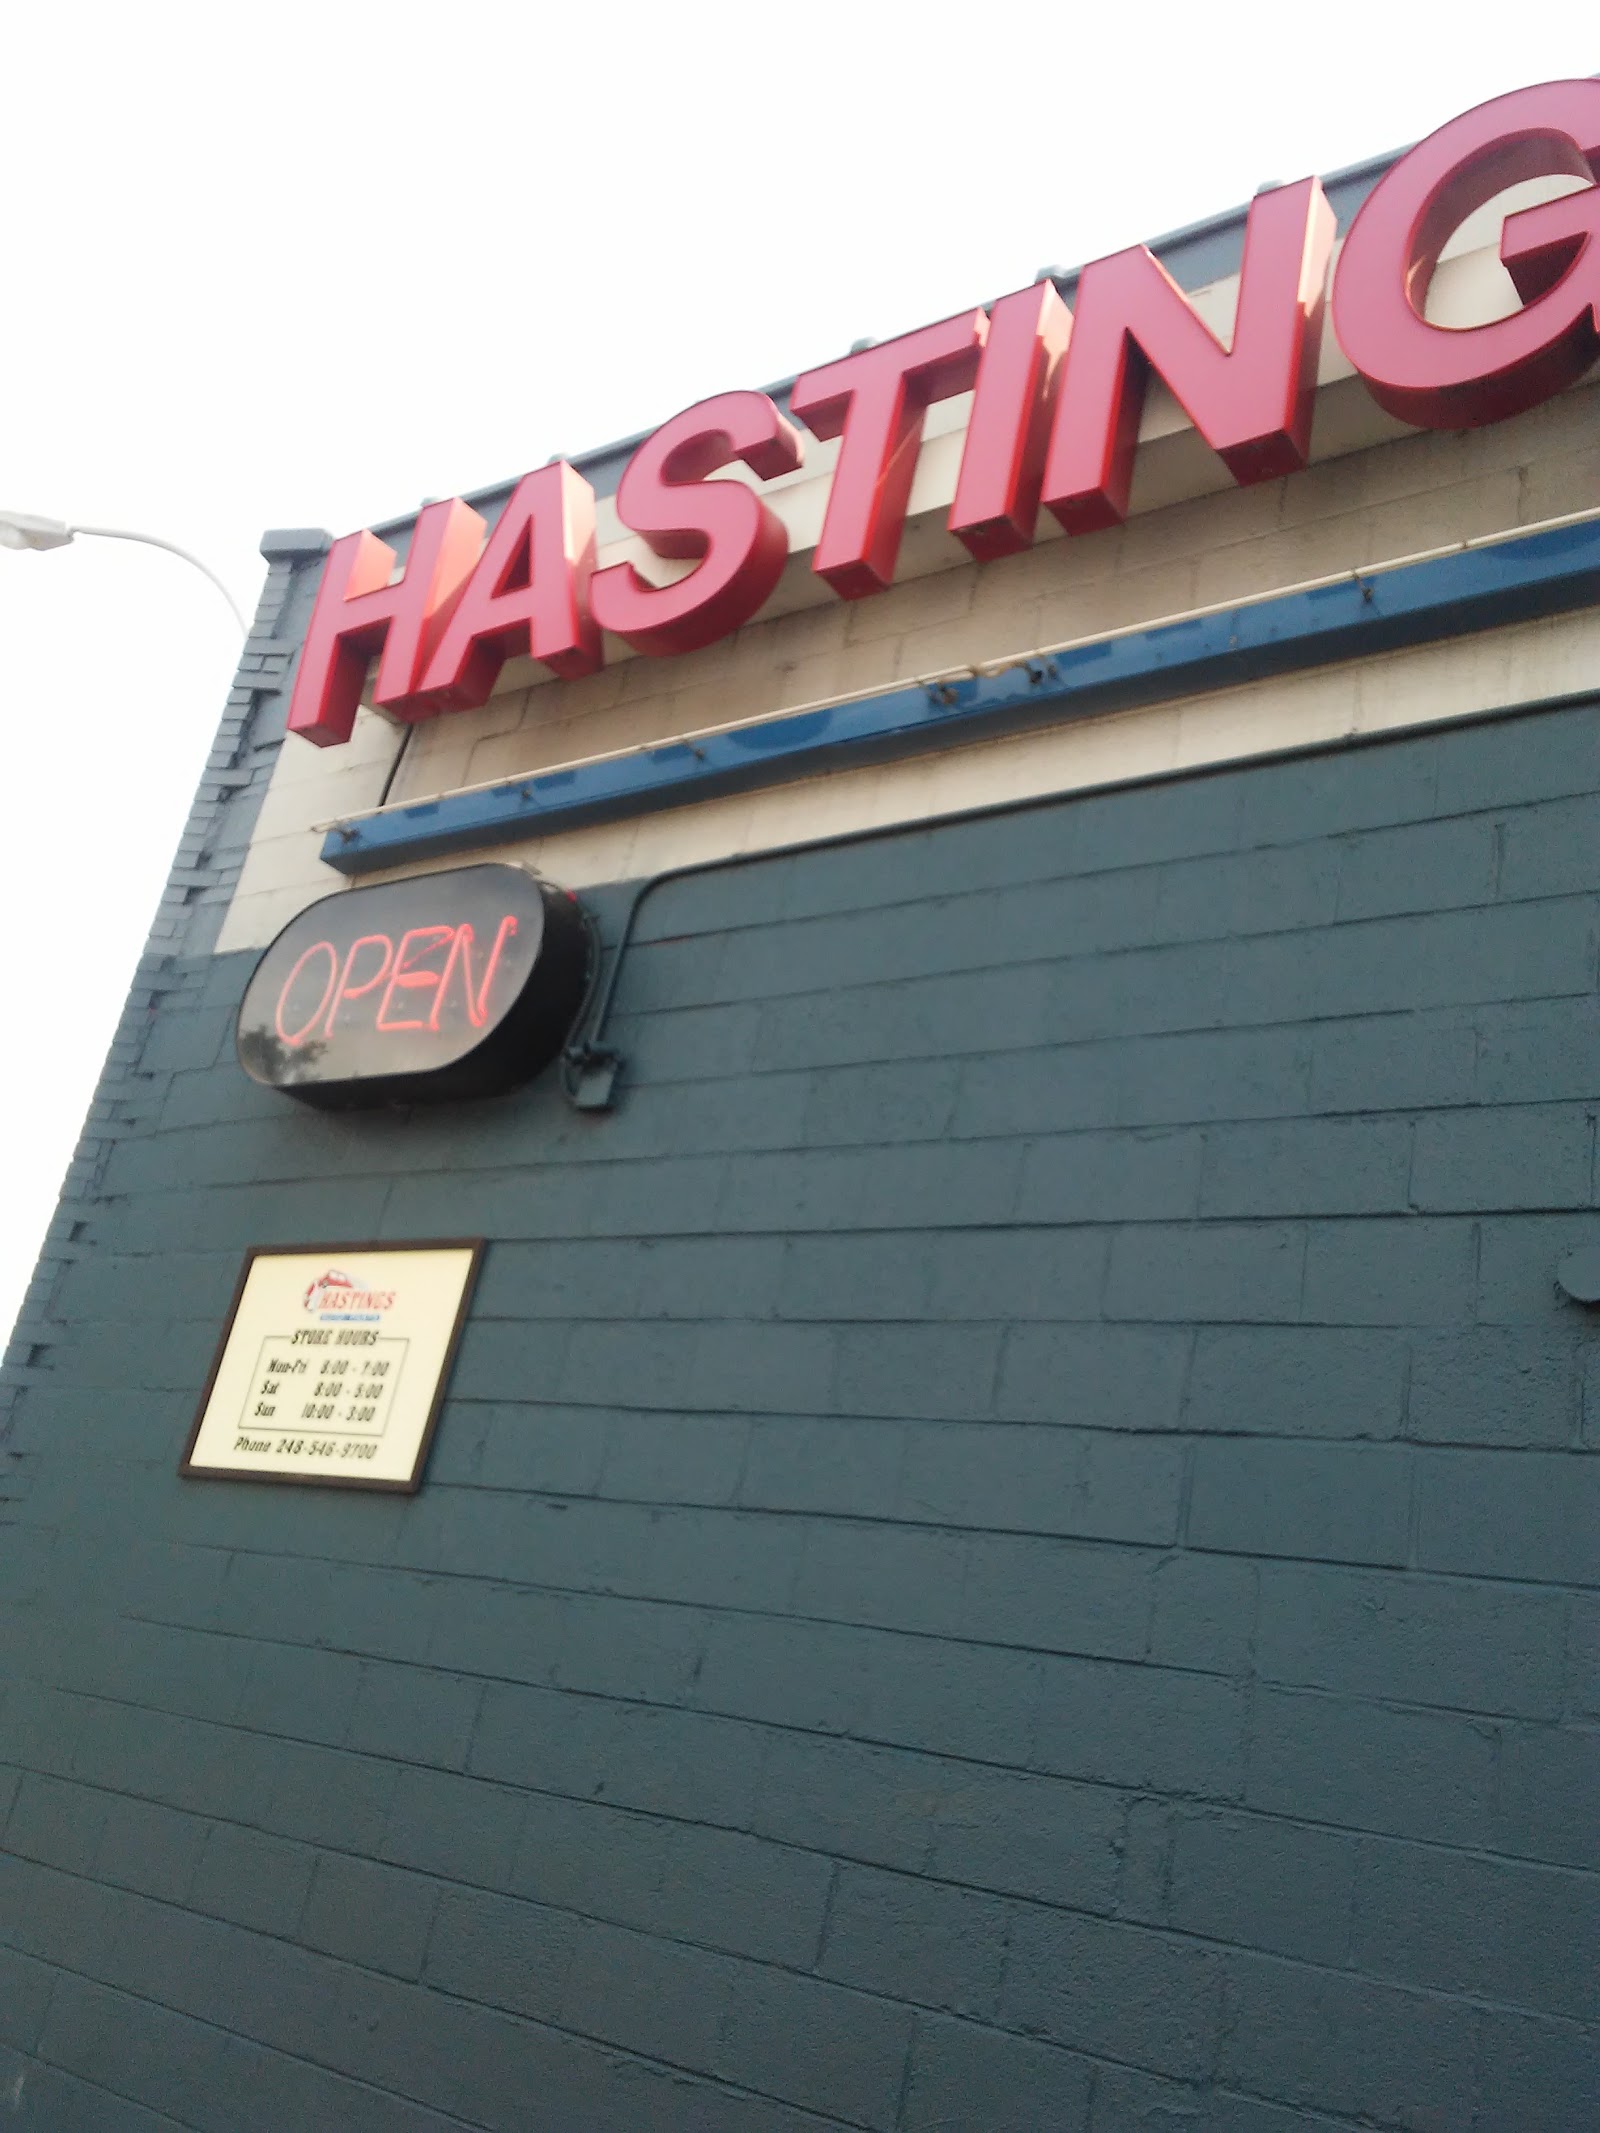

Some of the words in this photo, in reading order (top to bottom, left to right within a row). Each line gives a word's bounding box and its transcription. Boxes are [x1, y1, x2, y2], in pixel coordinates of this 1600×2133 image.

[275, 914, 519, 1046] OPEN
[319, 1291, 396, 1310] HASTINGS
[291, 1329, 333, 1345] STORE
[336, 1330, 380, 1346] HOURS
[268, 1358, 309, 1374] Mon-Fri
[320, 1360, 349, 1376] 8:00
[362, 1361, 390, 1377] 7:00
[261, 1380, 280, 1395] Sat
[314, 1381, 343, 1397] 8:00
[254, 1401, 276, 1417] Sun
[301, 1403, 335, 1420] 10:00
[346, 1405, 377, 1422] 3:00
[234, 1436, 272, 1454] Phone
